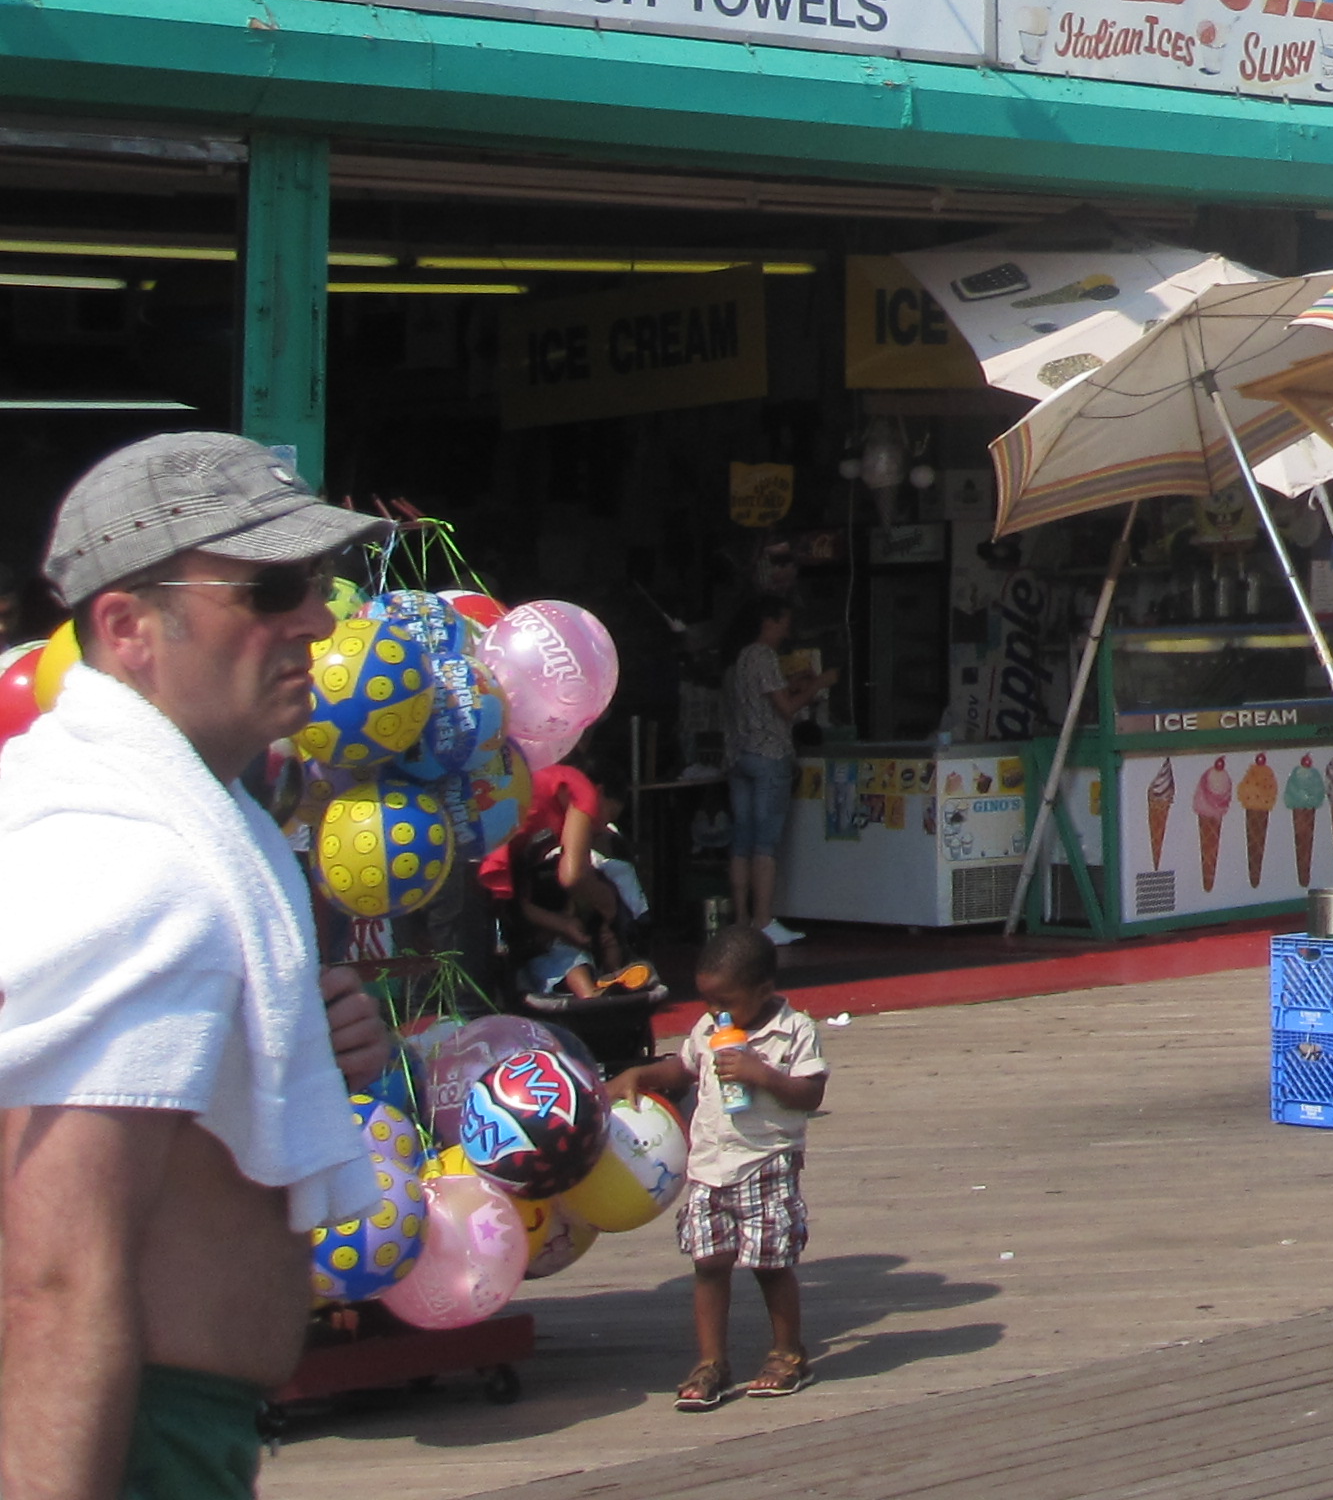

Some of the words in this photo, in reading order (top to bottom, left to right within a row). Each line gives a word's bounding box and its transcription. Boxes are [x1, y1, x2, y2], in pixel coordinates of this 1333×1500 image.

[1054, 12, 1143, 60] Italian
[1239, 31, 1316, 82] SLUSH
[874, 287, 948, 346] ICE
[527, 326, 591, 386] ICE
[607, 303, 741, 373] CREAM
[1155, 713, 1198, 733] ICE
[1220, 708, 1297, 729] CREAM
[973, 800, 1021, 814] GINO'S
[508, 1053, 561, 1118] DIVA
